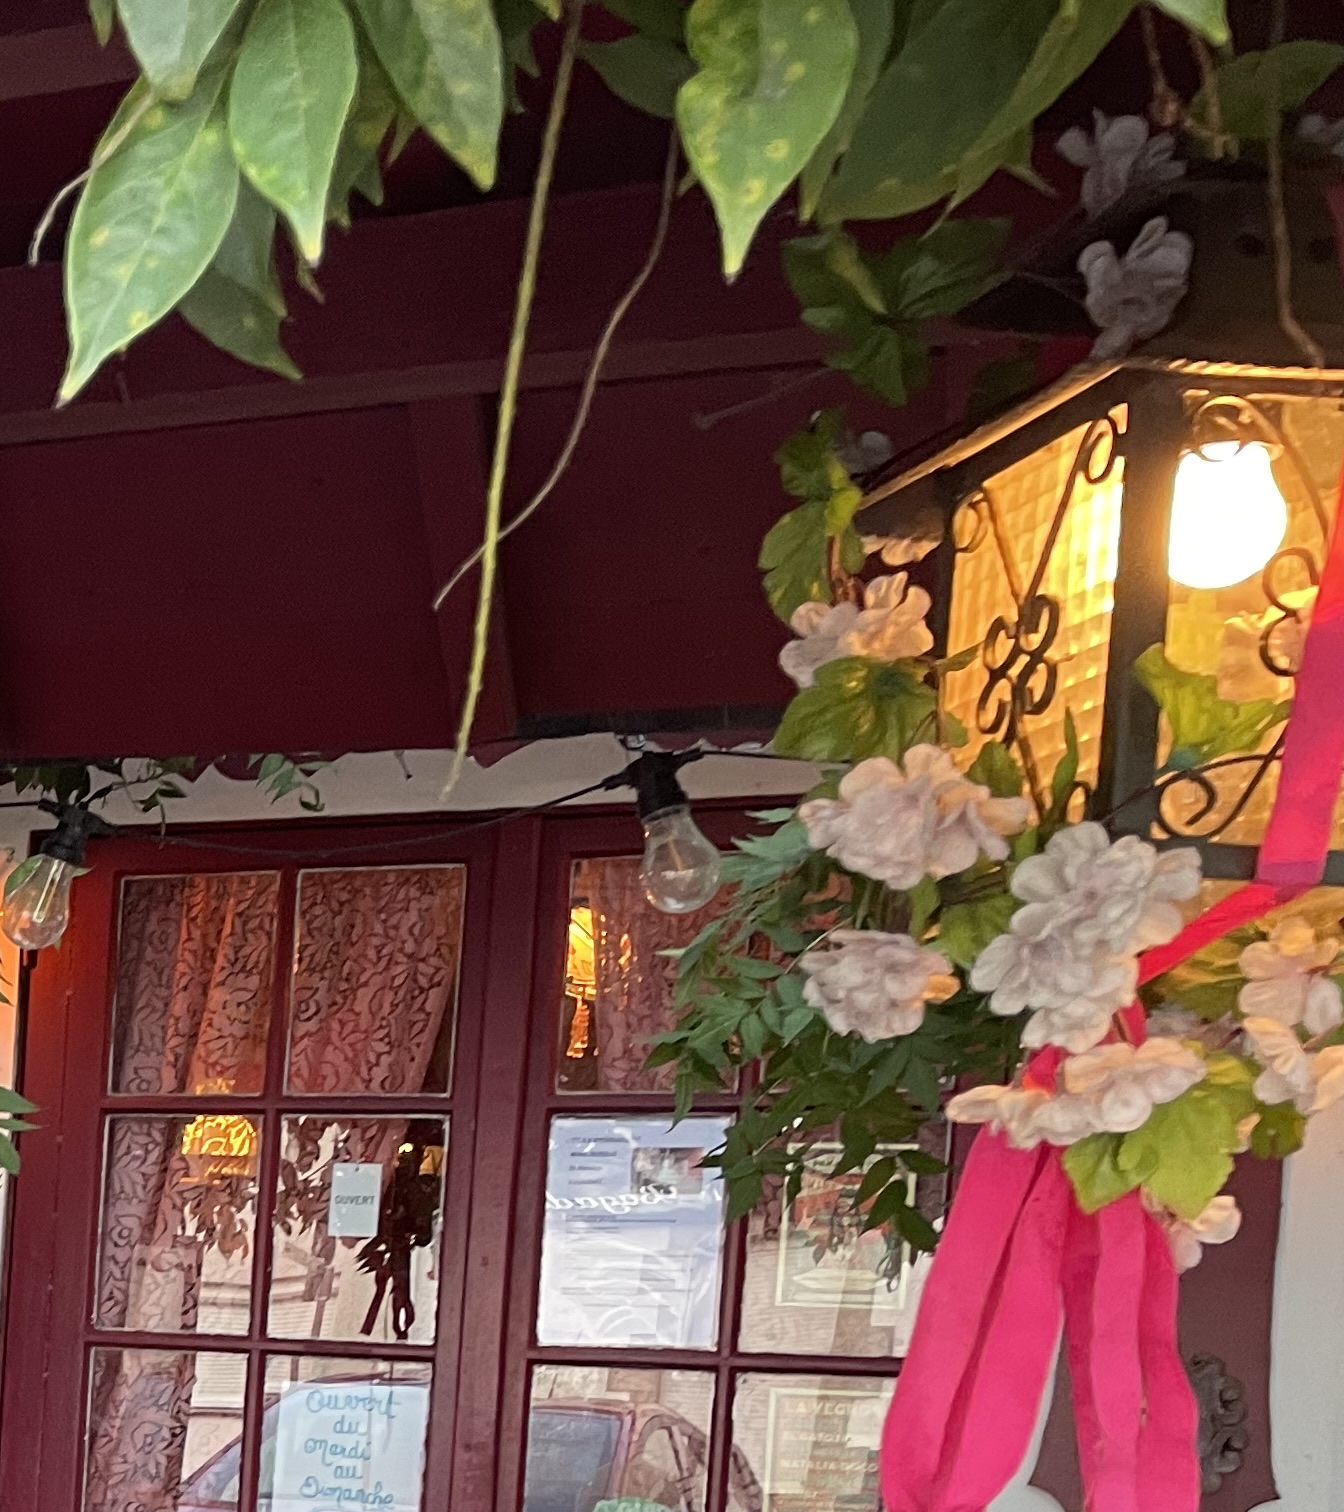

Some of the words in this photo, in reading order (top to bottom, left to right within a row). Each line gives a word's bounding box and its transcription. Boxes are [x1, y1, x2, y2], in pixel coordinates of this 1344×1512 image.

[335, 1195, 375, 1205] OUVERT
[306, 1389, 400, 1418] Ouvert
[333, 1416, 368, 1435] du
[305, 1437, 372, 1466] Mardi
[333, 1465, 363, 1480] au
[299, 1475, 395, 1507] Dimanche
